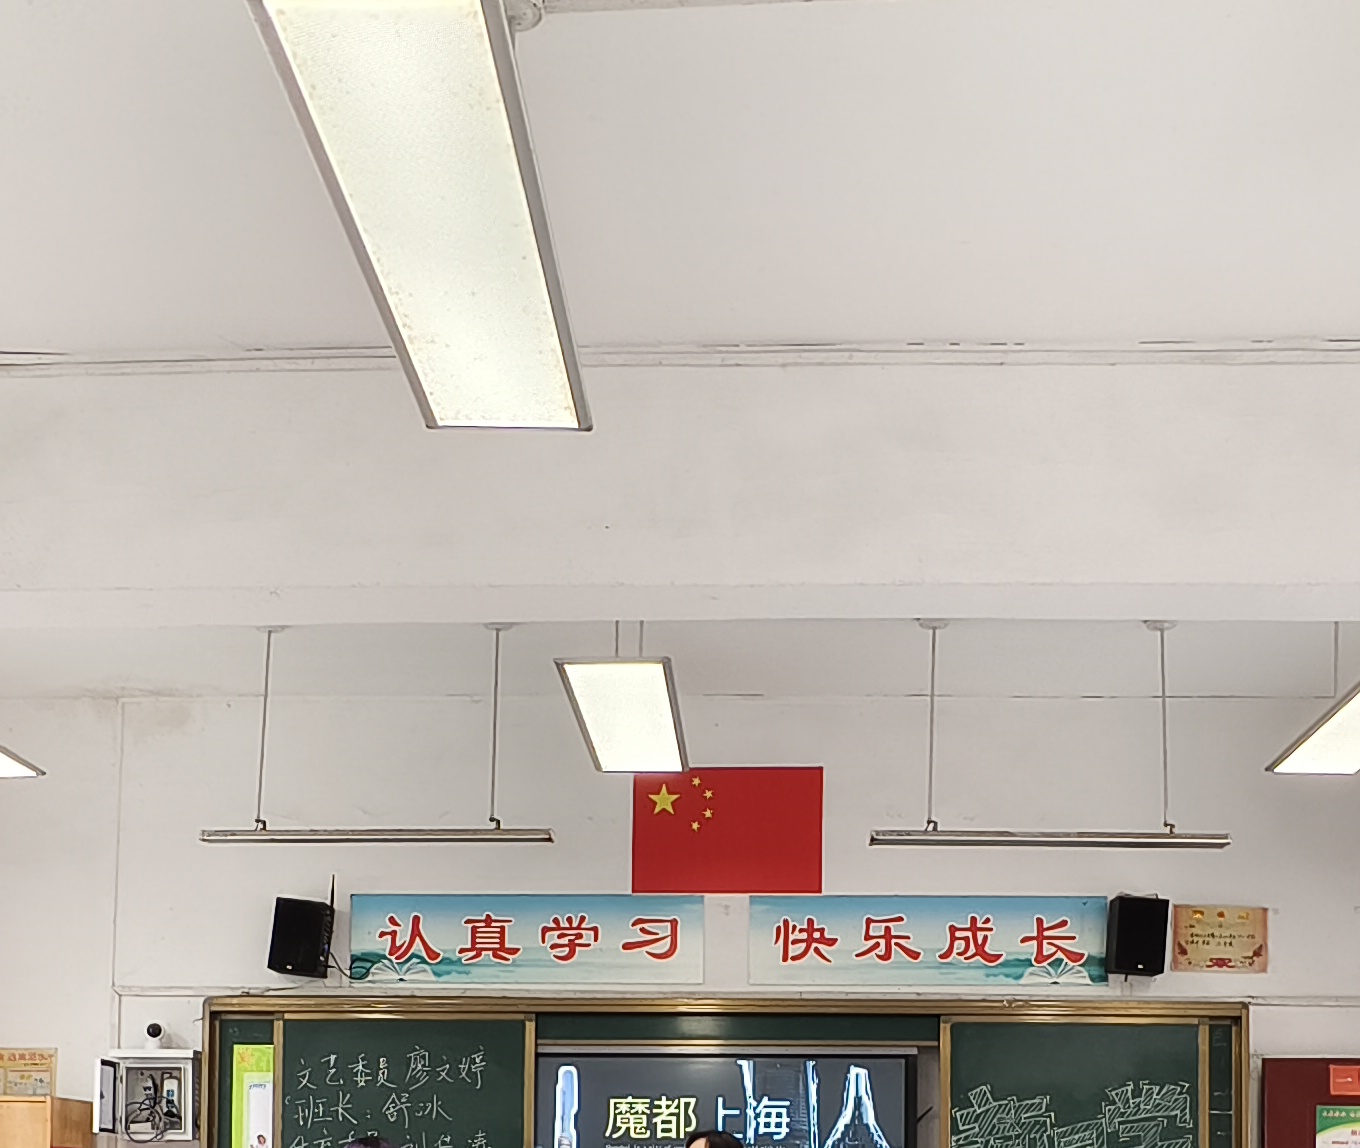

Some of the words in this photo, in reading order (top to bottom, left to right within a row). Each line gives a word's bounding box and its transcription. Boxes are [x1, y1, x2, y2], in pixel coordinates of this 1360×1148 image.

[379, 915, 680, 962] 认真学习
[774, 915, 1086, 965] 快乐成长
[605, 1095, 698, 1140] 魔都
[717, 1095, 792, 1142] 上海
